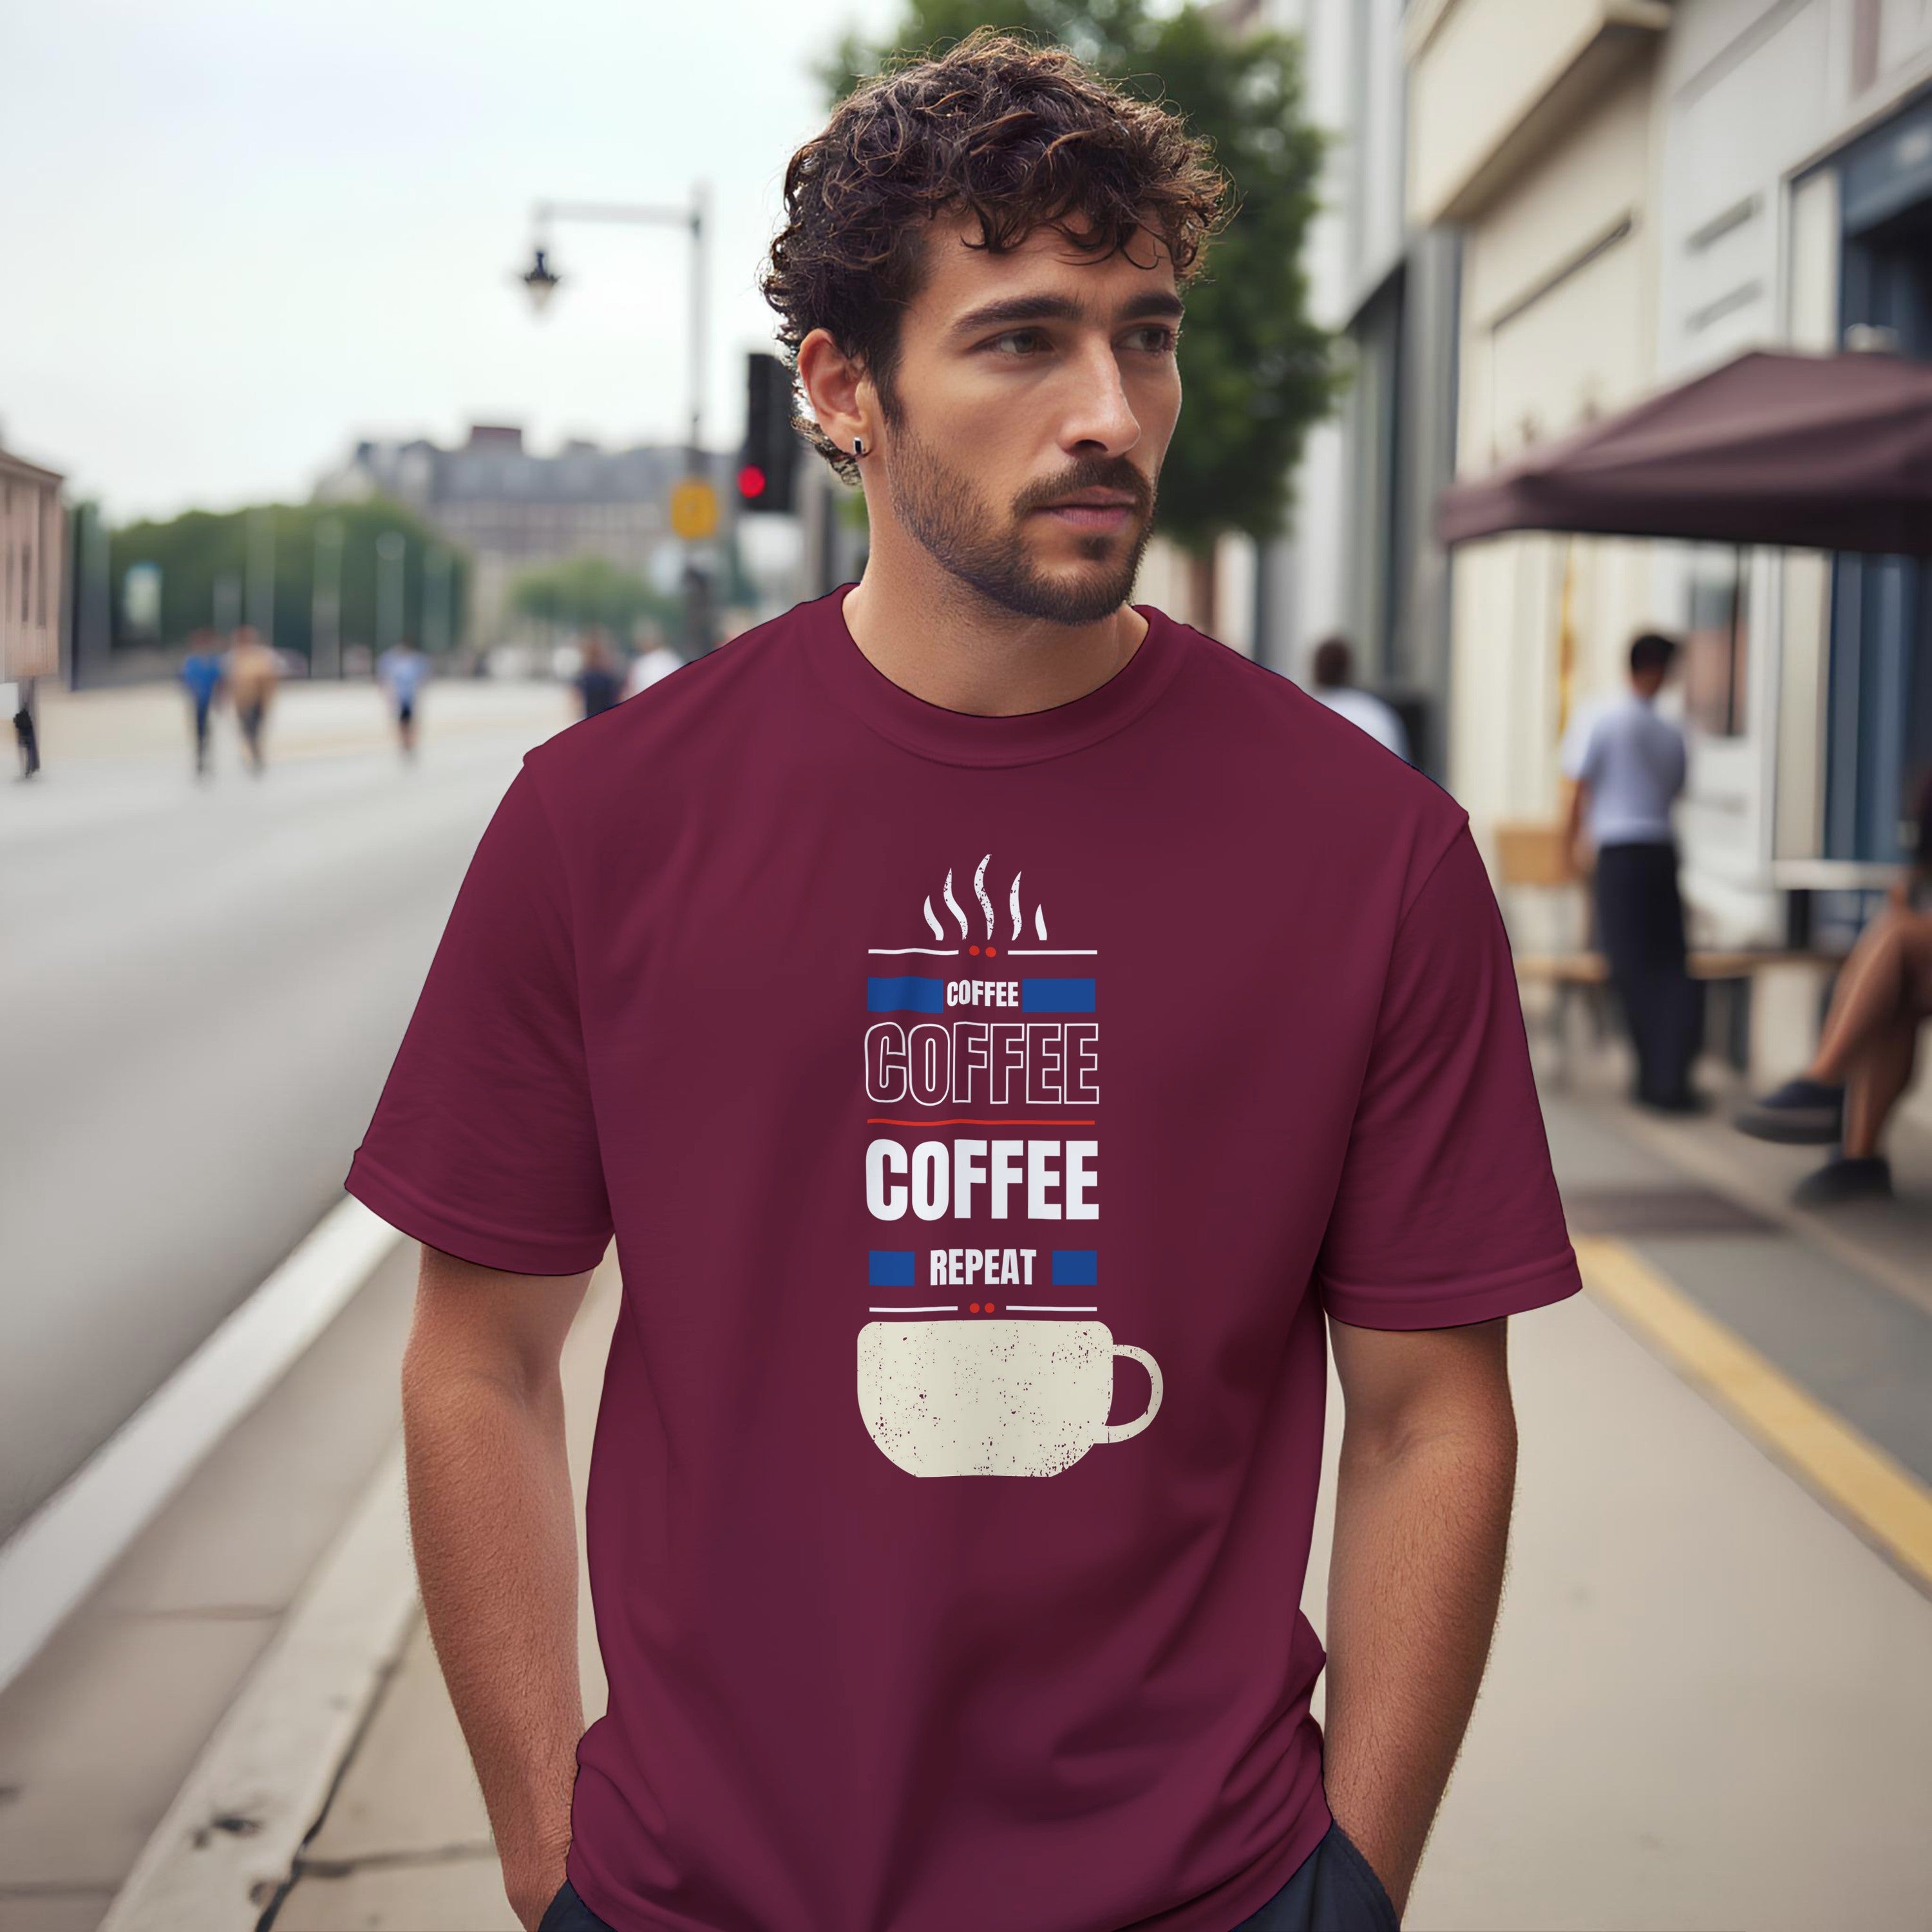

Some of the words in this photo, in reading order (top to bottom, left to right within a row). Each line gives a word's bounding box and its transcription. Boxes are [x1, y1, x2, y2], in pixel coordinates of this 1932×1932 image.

[947, 980, 1018, 1006] COFFEE
[865, 1021, 1099, 1106] COFFEE
[866, 1139, 1099, 1220] COFFEE
[931, 1249, 1036, 1285] REPEAT
